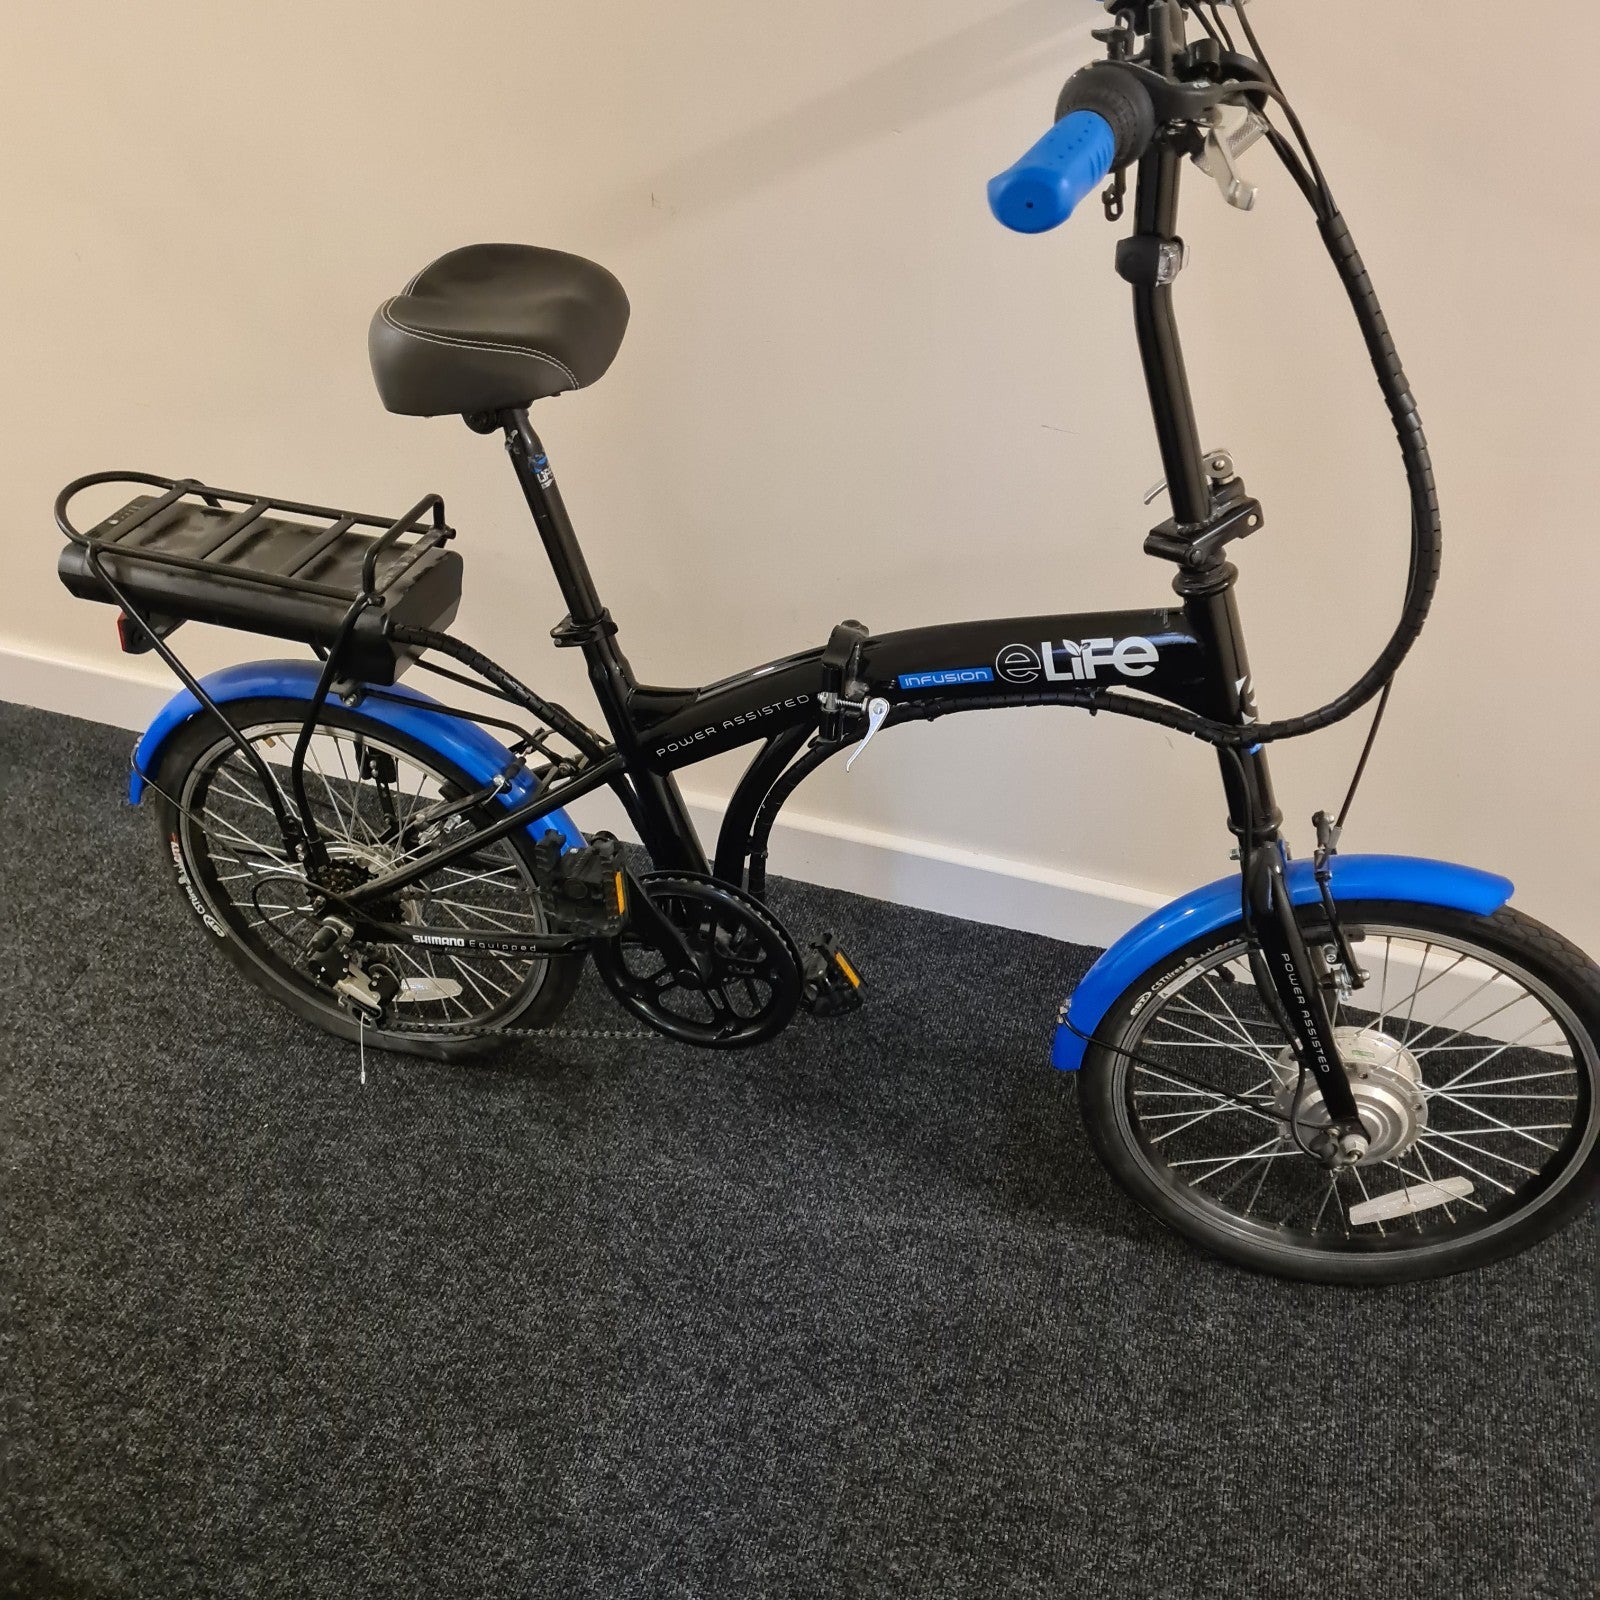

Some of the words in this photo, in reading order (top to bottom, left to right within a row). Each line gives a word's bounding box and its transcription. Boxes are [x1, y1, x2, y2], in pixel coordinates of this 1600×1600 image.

[904, 669, 988, 687] INFUSION
[655, 726, 718, 758] POWER
[722, 694, 810, 730] ASSISTED
[412, 934, 465, 947] SHIMANO
[469, 939, 537, 952] Equipped
[1281, 953, 1306, 1005] POWER
[1301, 1010, 1330, 1073] ASSISTED
